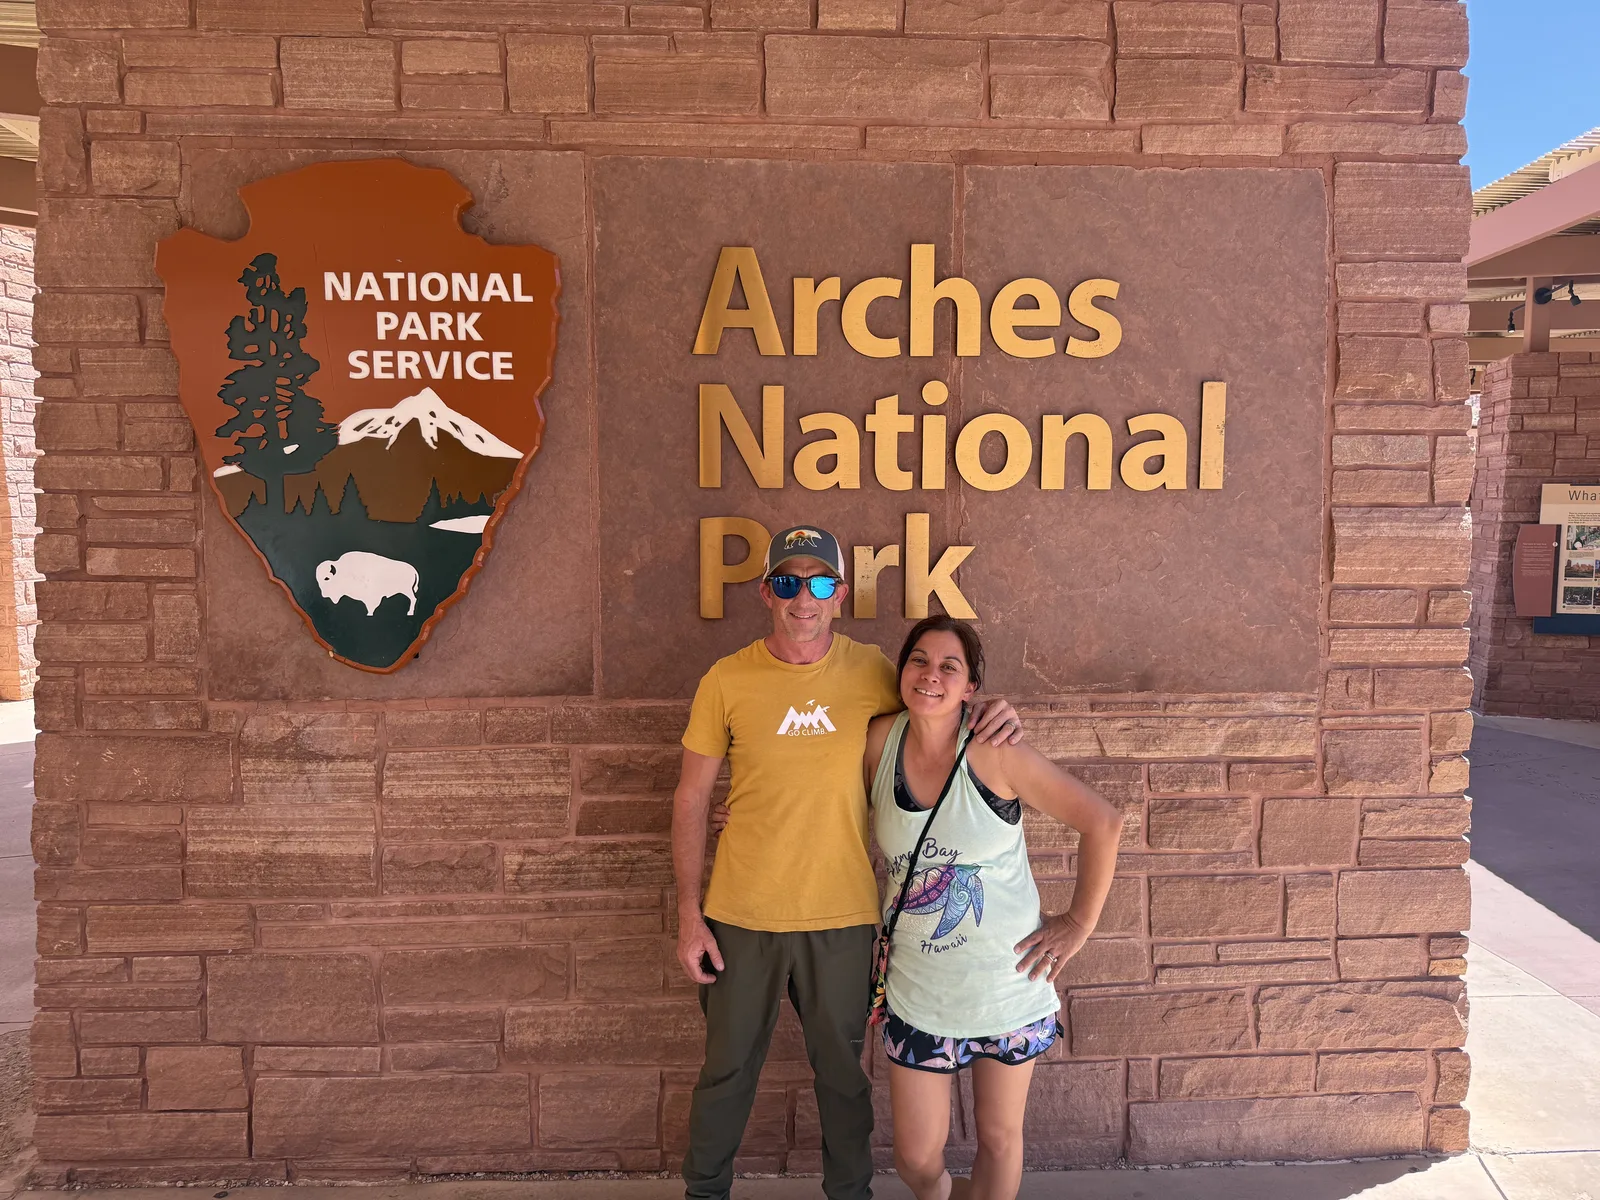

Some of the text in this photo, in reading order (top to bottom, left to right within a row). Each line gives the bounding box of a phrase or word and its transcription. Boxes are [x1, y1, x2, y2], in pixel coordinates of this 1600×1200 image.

[323, 271, 534, 303] NATIONAL
[692, 243, 1123, 359] Arches
[376, 311, 484, 341] PARK
[347, 350, 515, 381] SERVICE
[698, 380, 1227, 492] National
[1568, 489, 1600, 501] Wha
[699, 512, 979, 620] Prk
[787, 729, 800, 737] GO
[921, 837, 963, 864] Bay
[920, 933, 968, 955] Hawaii
